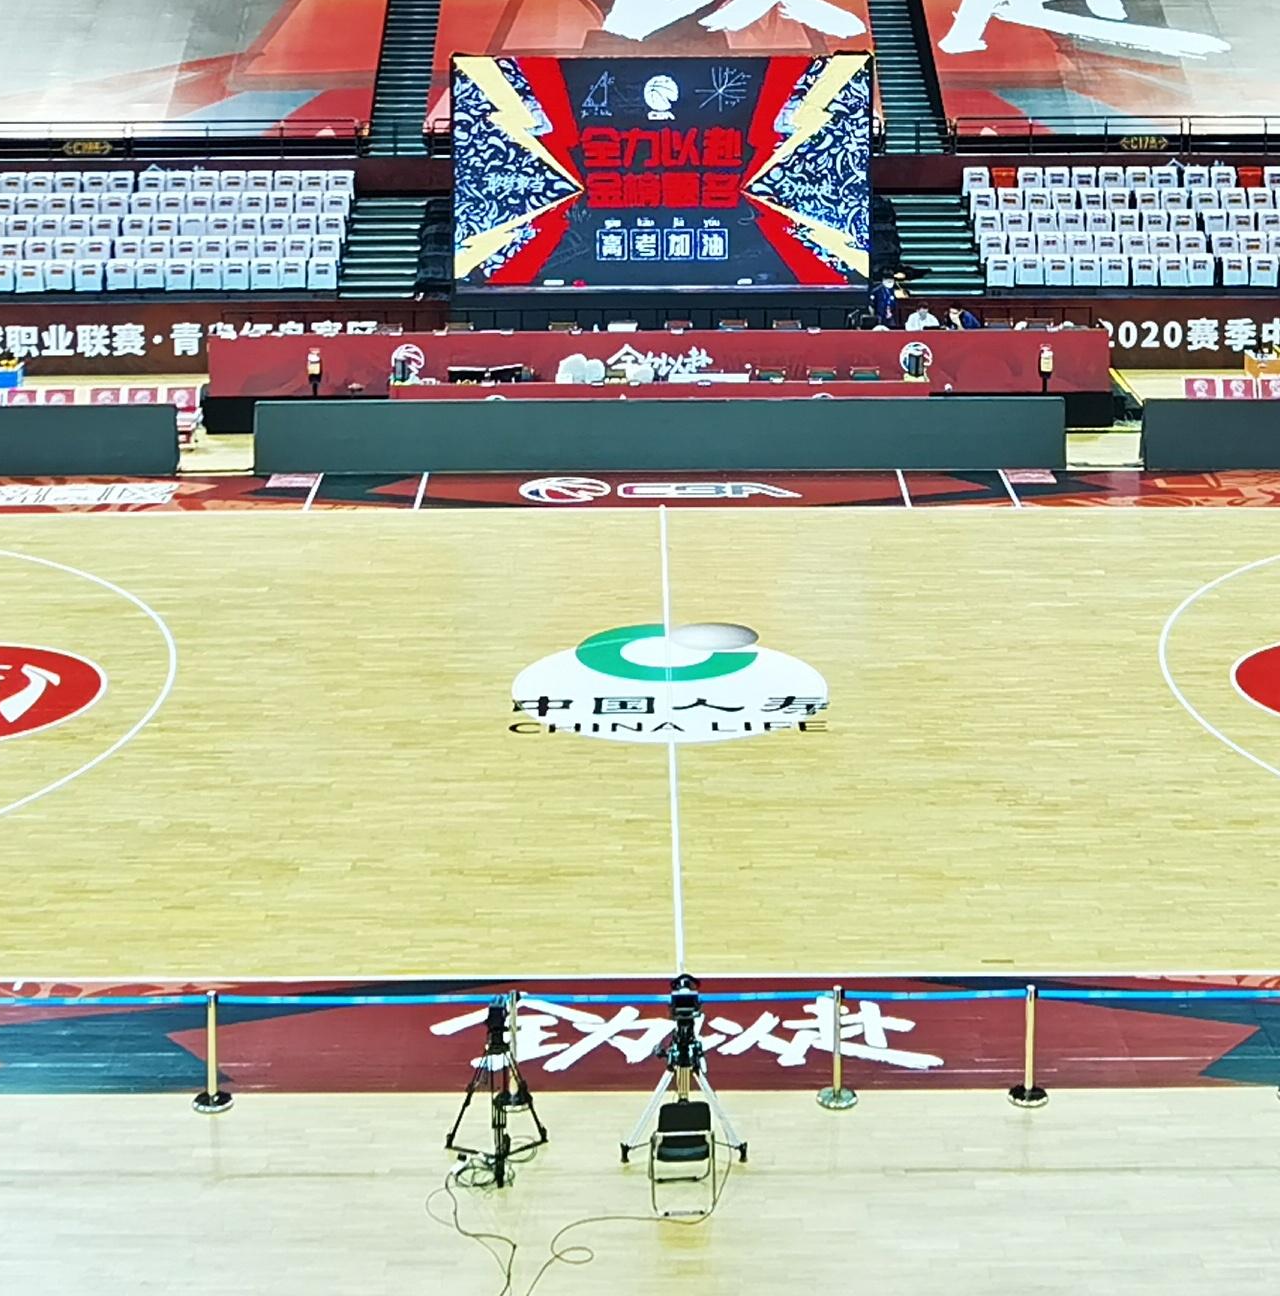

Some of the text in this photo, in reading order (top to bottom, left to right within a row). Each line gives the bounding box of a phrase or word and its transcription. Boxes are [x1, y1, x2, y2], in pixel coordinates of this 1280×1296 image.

[581, 126, 743, 168] 全力以赴
[601, 233, 723, 258] 高考加油
[616, 482, 804, 498] CBA
[511, 693, 829, 717] 中国人寿
[508, 720, 828, 734] CHINA LIFE
